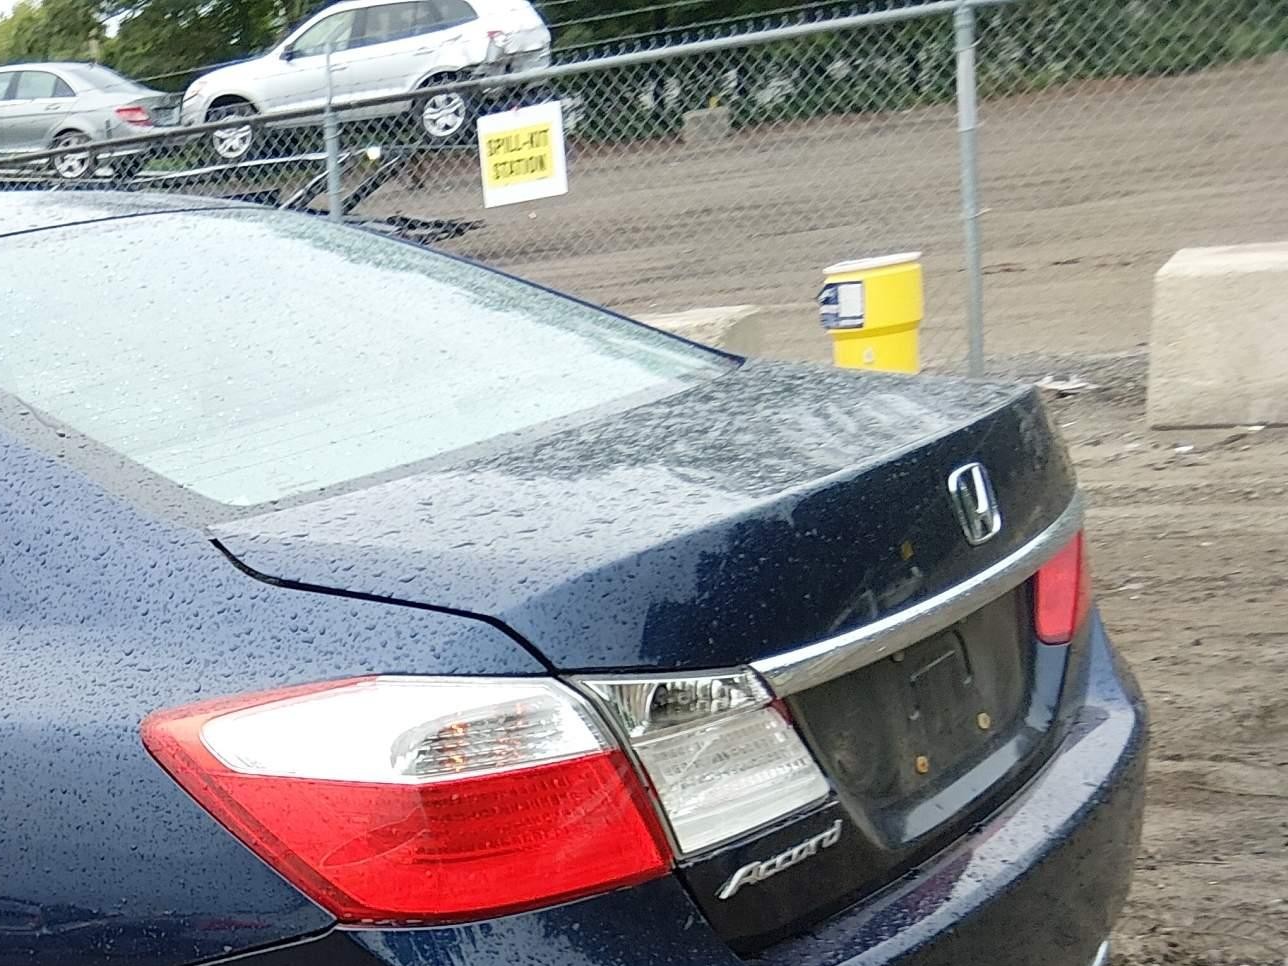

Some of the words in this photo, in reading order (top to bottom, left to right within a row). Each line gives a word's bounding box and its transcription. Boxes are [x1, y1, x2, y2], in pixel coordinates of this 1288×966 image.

[487, 128, 550, 156] SPILL-KIT
[493, 153, 547, 179] STATION
[714, 818, 843, 900] Accord
